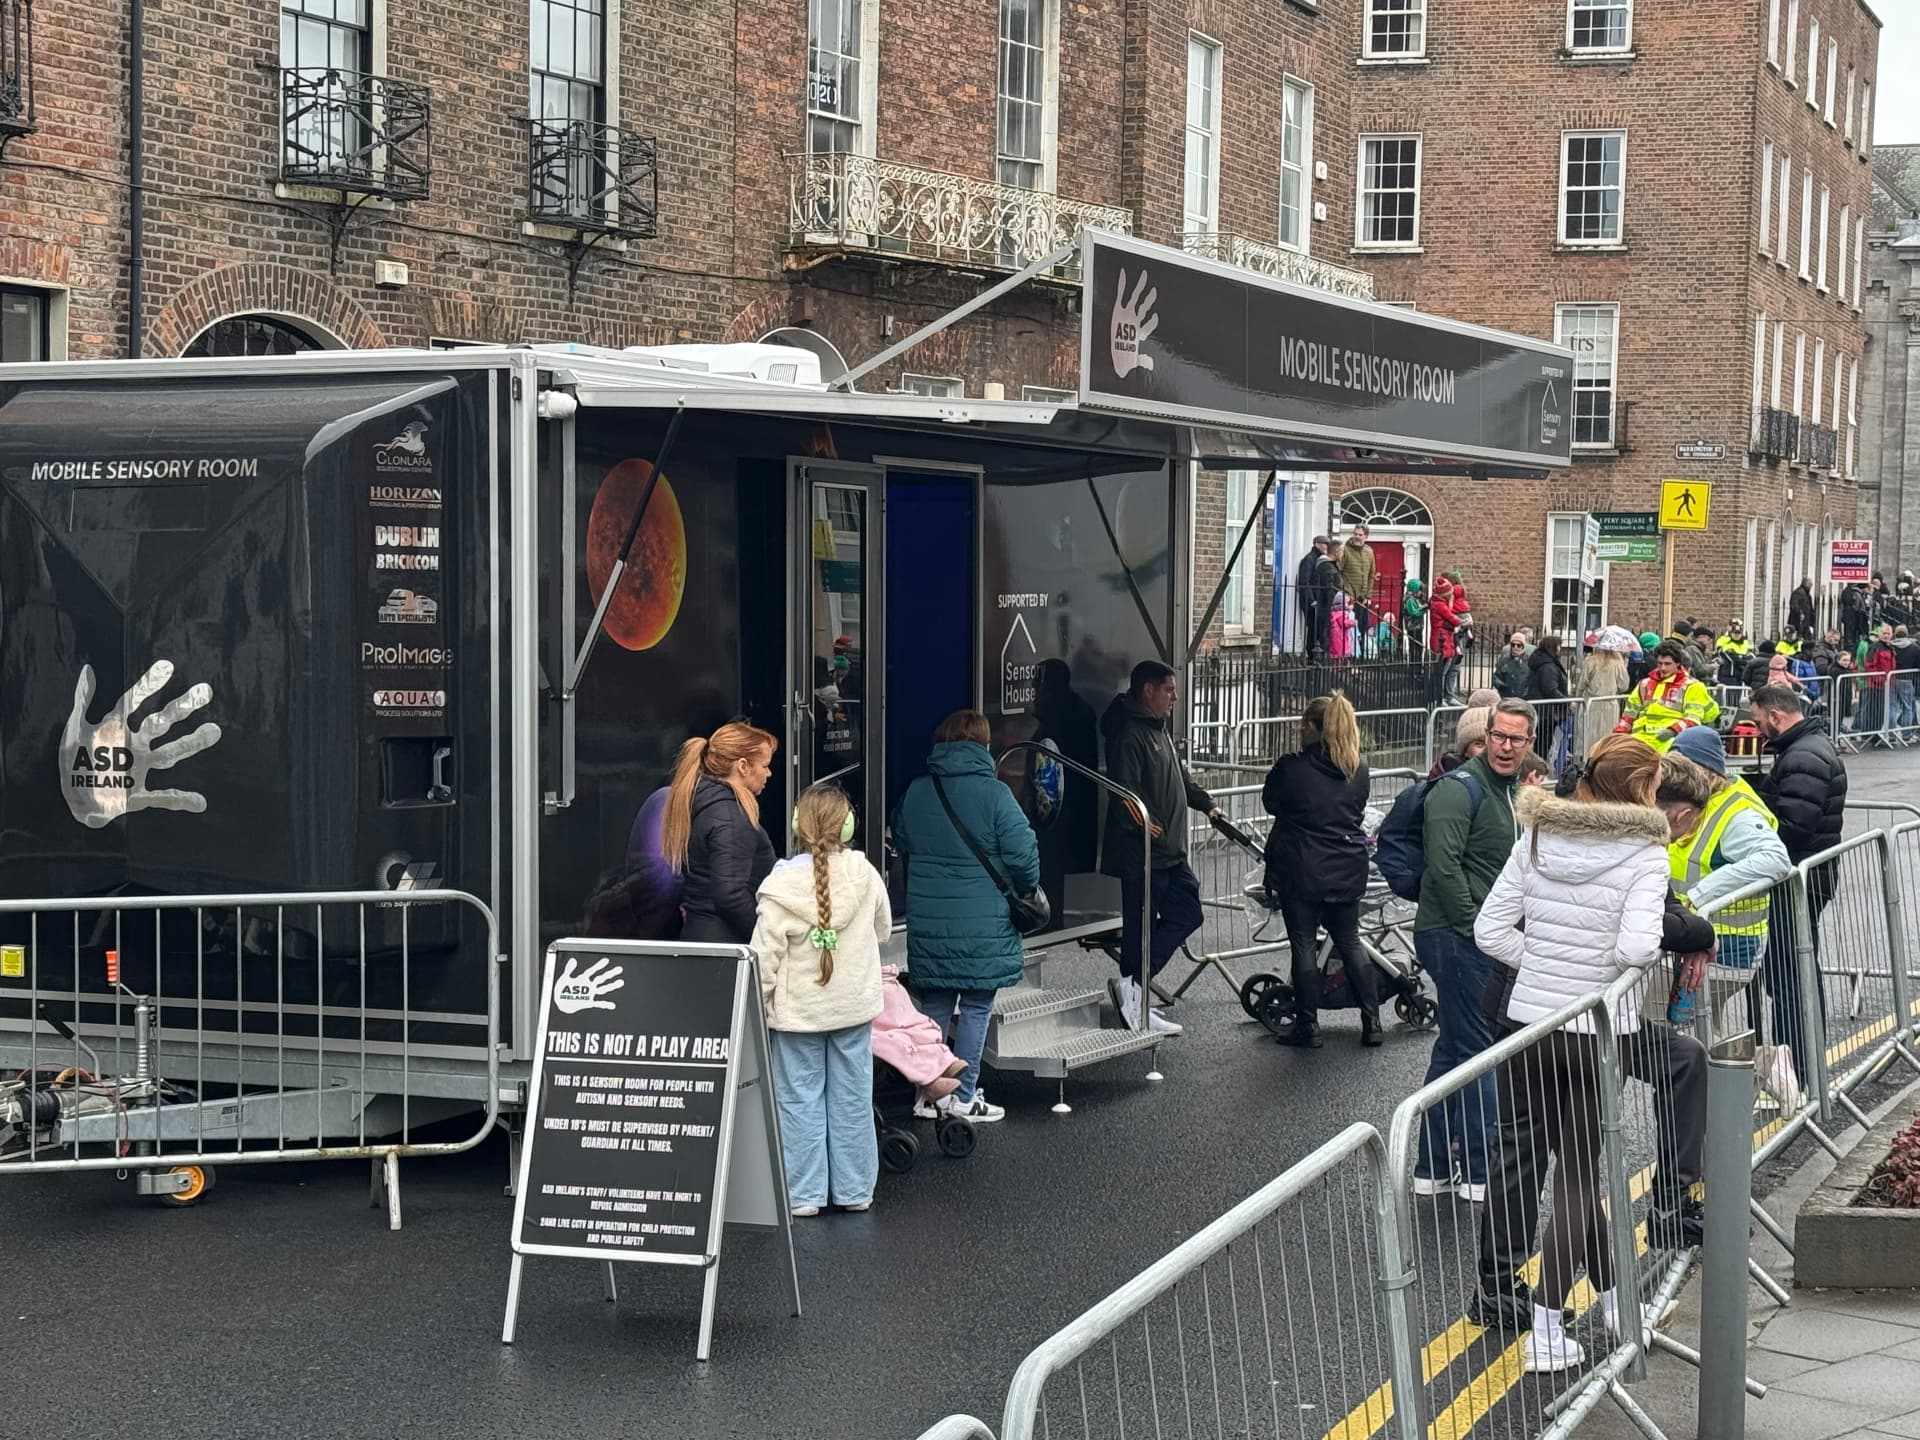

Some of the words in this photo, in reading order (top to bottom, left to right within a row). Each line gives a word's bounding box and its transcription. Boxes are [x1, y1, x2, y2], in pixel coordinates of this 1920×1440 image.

[1116, 322, 1136, 341] ASD
[1280, 335, 1340, 386] MOBILE
[1344, 350, 1409, 398] SENSORY
[1413, 363, 1455, 405] ROOM
[1544, 409, 1561, 428] Sensory
[376, 450, 432, 466] CLONLARA
[32, 462, 102, 480] MOBILE
[106, 460, 194, 480] SENSORY
[197, 458, 258, 478] ROOM
[370, 486, 442, 500] HORIZON
[375, 525, 440, 548] DUBLIN
[376, 553, 440, 570] BRICKCON
[998, 594, 1038, 608] SUPPORTED
[1039, 593, 1048, 608] BY
[1006, 662, 1046, 683] Sensory
[1006, 684, 1036, 704] House
[72, 746, 134, 772] ASD
[72, 774, 135, 788] IRELAND
[562, 985, 590, 994] ASD
[548, 1032, 580, 1054] THIS
[584, 1033, 600, 1054] IS
[603, 1034, 634, 1056] NOT
[636, 1035, 647, 1056] A
[650, 1036, 688, 1058] PLAY
[692, 1038, 728, 1060] AREA
[554, 1074, 571, 1086] THIS
[572, 1076, 580, 1087] IS
[582, 1076, 588, 1088] A
[589, 1077, 624, 1089] SENSORY
[624, 1078, 648, 1090] ROOM
[649, 1079, 664, 1090] FOR
[666, 1080, 692, 1092] PEOPLE
[695, 1081, 714, 1093] WITH
[576, 1092, 606, 1104] AUTISM
[607, 1094, 622, 1106] AND
[624, 1095, 658, 1107] SENSORY
[660, 1096, 686, 1108] NEEDS.
[544, 1118, 568, 1130] UNDER
[588, 1120, 610, 1132] MUST
[612, 1121, 622, 1132] BE
[623, 1122, 668, 1134] SUPERVISED
[670, 1124, 680, 1136] BY
[581, 1136, 619, 1150] GUARDIAN
[620, 1138, 630, 1150] AT
[632, 1139, 646, 1150] ALL
[648, 1140, 673, 1152] TIMES.
[542, 1184, 554, 1194] ASD
[608, 1188, 644, 1200] VOLUNTEERS
[646, 1190, 662, 1200] HAVE
[662, 1192, 674, 1201] THE
[675, 1192, 692, 1202] RIGHT
[694, 1193, 702, 1202] TO
[558, 1218, 570, 1228] LIVE
[571, 1219, 586, 1230] CCTV
[587, 1220, 594, 1230] IN
[595, 1221, 628, 1232] OPERATION
[628, 1222, 640, 1232] FOR
[640, 1223, 659, 1234] CHILD
[660, 1224, 696, 1236] PROTECTION
[586, 1234, 600, 1244] AND
[622, 1236, 645, 1247] SAFETY
